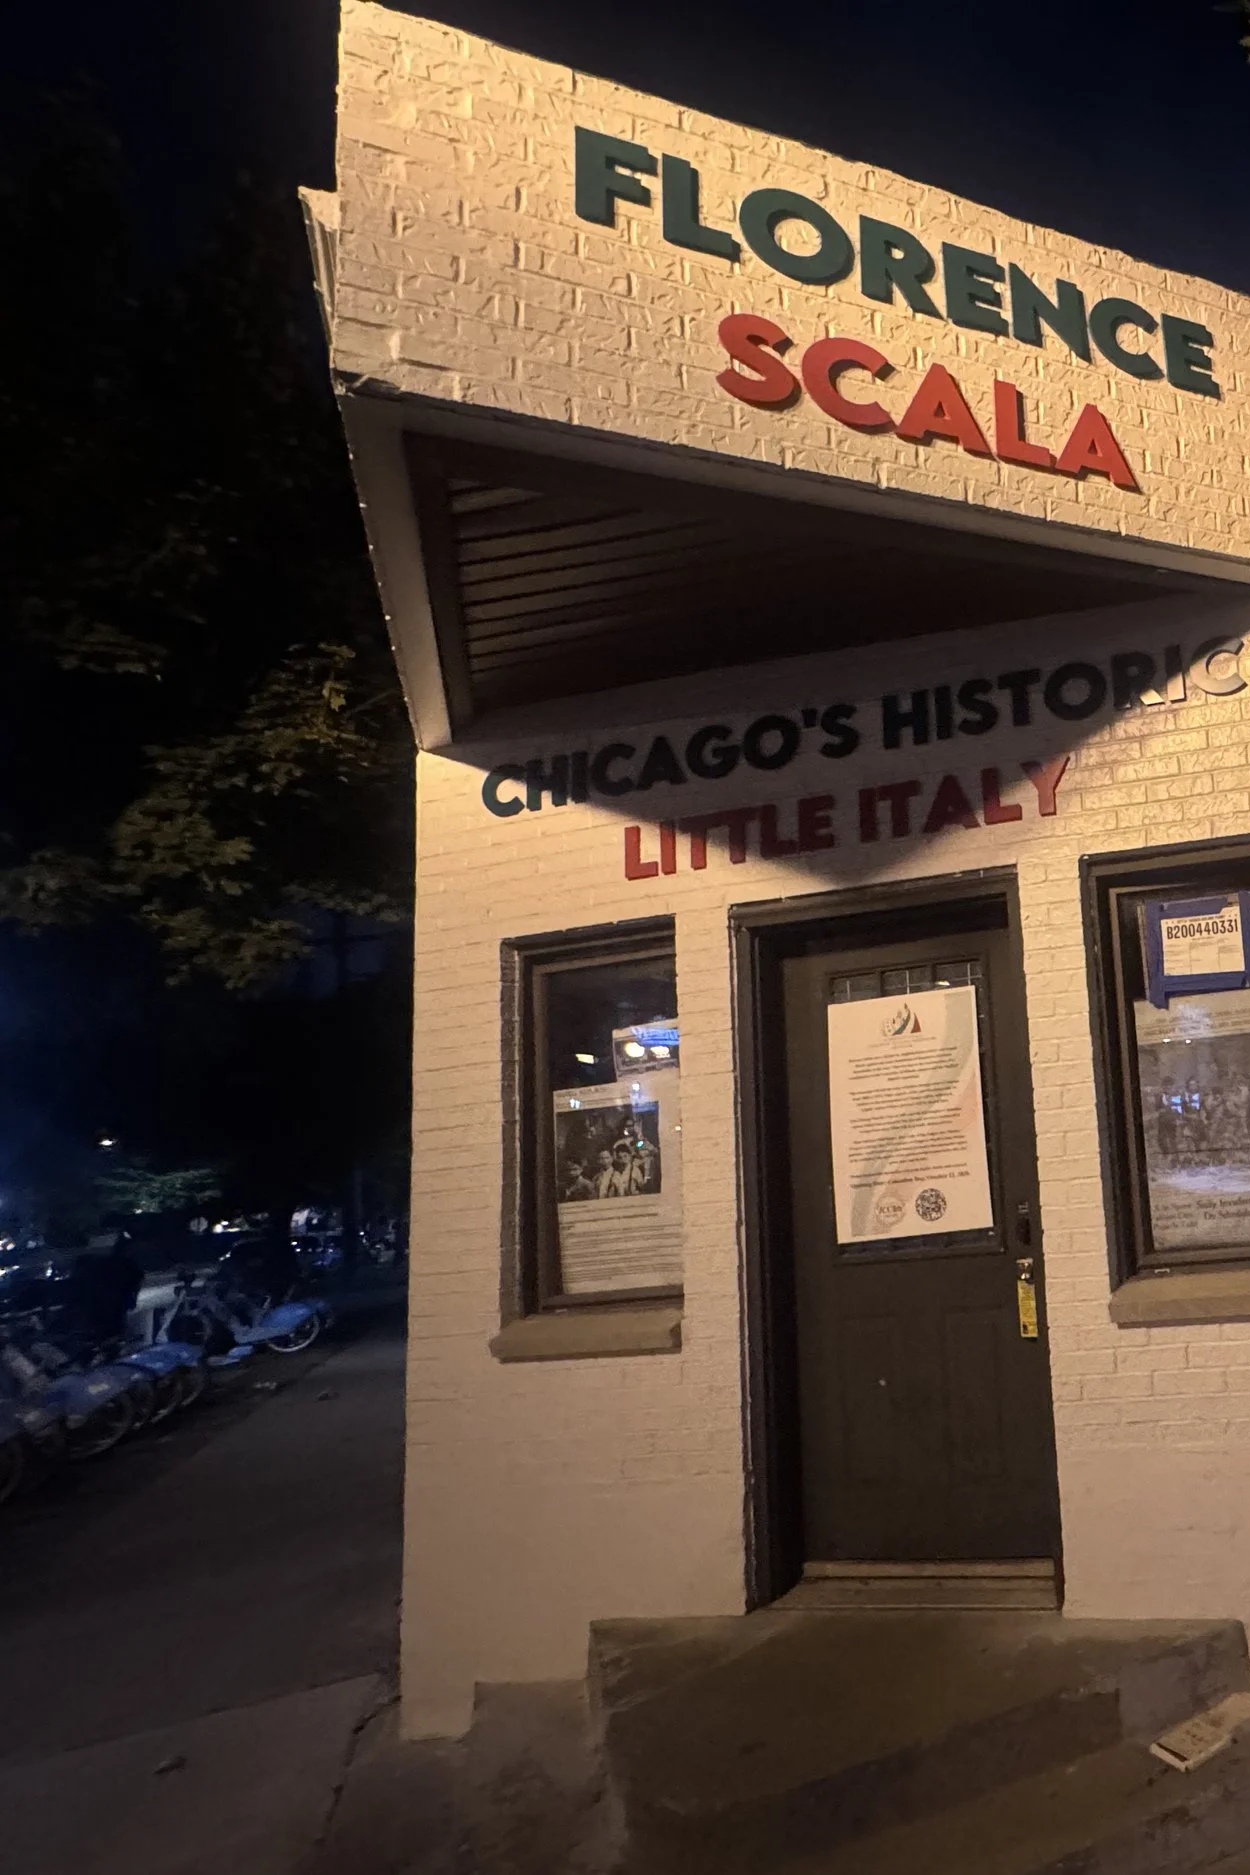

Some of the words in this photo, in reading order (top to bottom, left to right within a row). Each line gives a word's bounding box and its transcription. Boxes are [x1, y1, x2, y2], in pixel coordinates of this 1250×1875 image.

[575, 126, 1221, 399] FLORENCE
[715, 313, 1142, 494] SCALA
[481, 703, 859, 819] CHICAGO'S
[882, 635, 1250, 750] HISTORIC
[624, 794, 835, 881] LITTLE
[858, 755, 1070, 843] ITALY
[1166, 918, 1239, 940] B200440331
